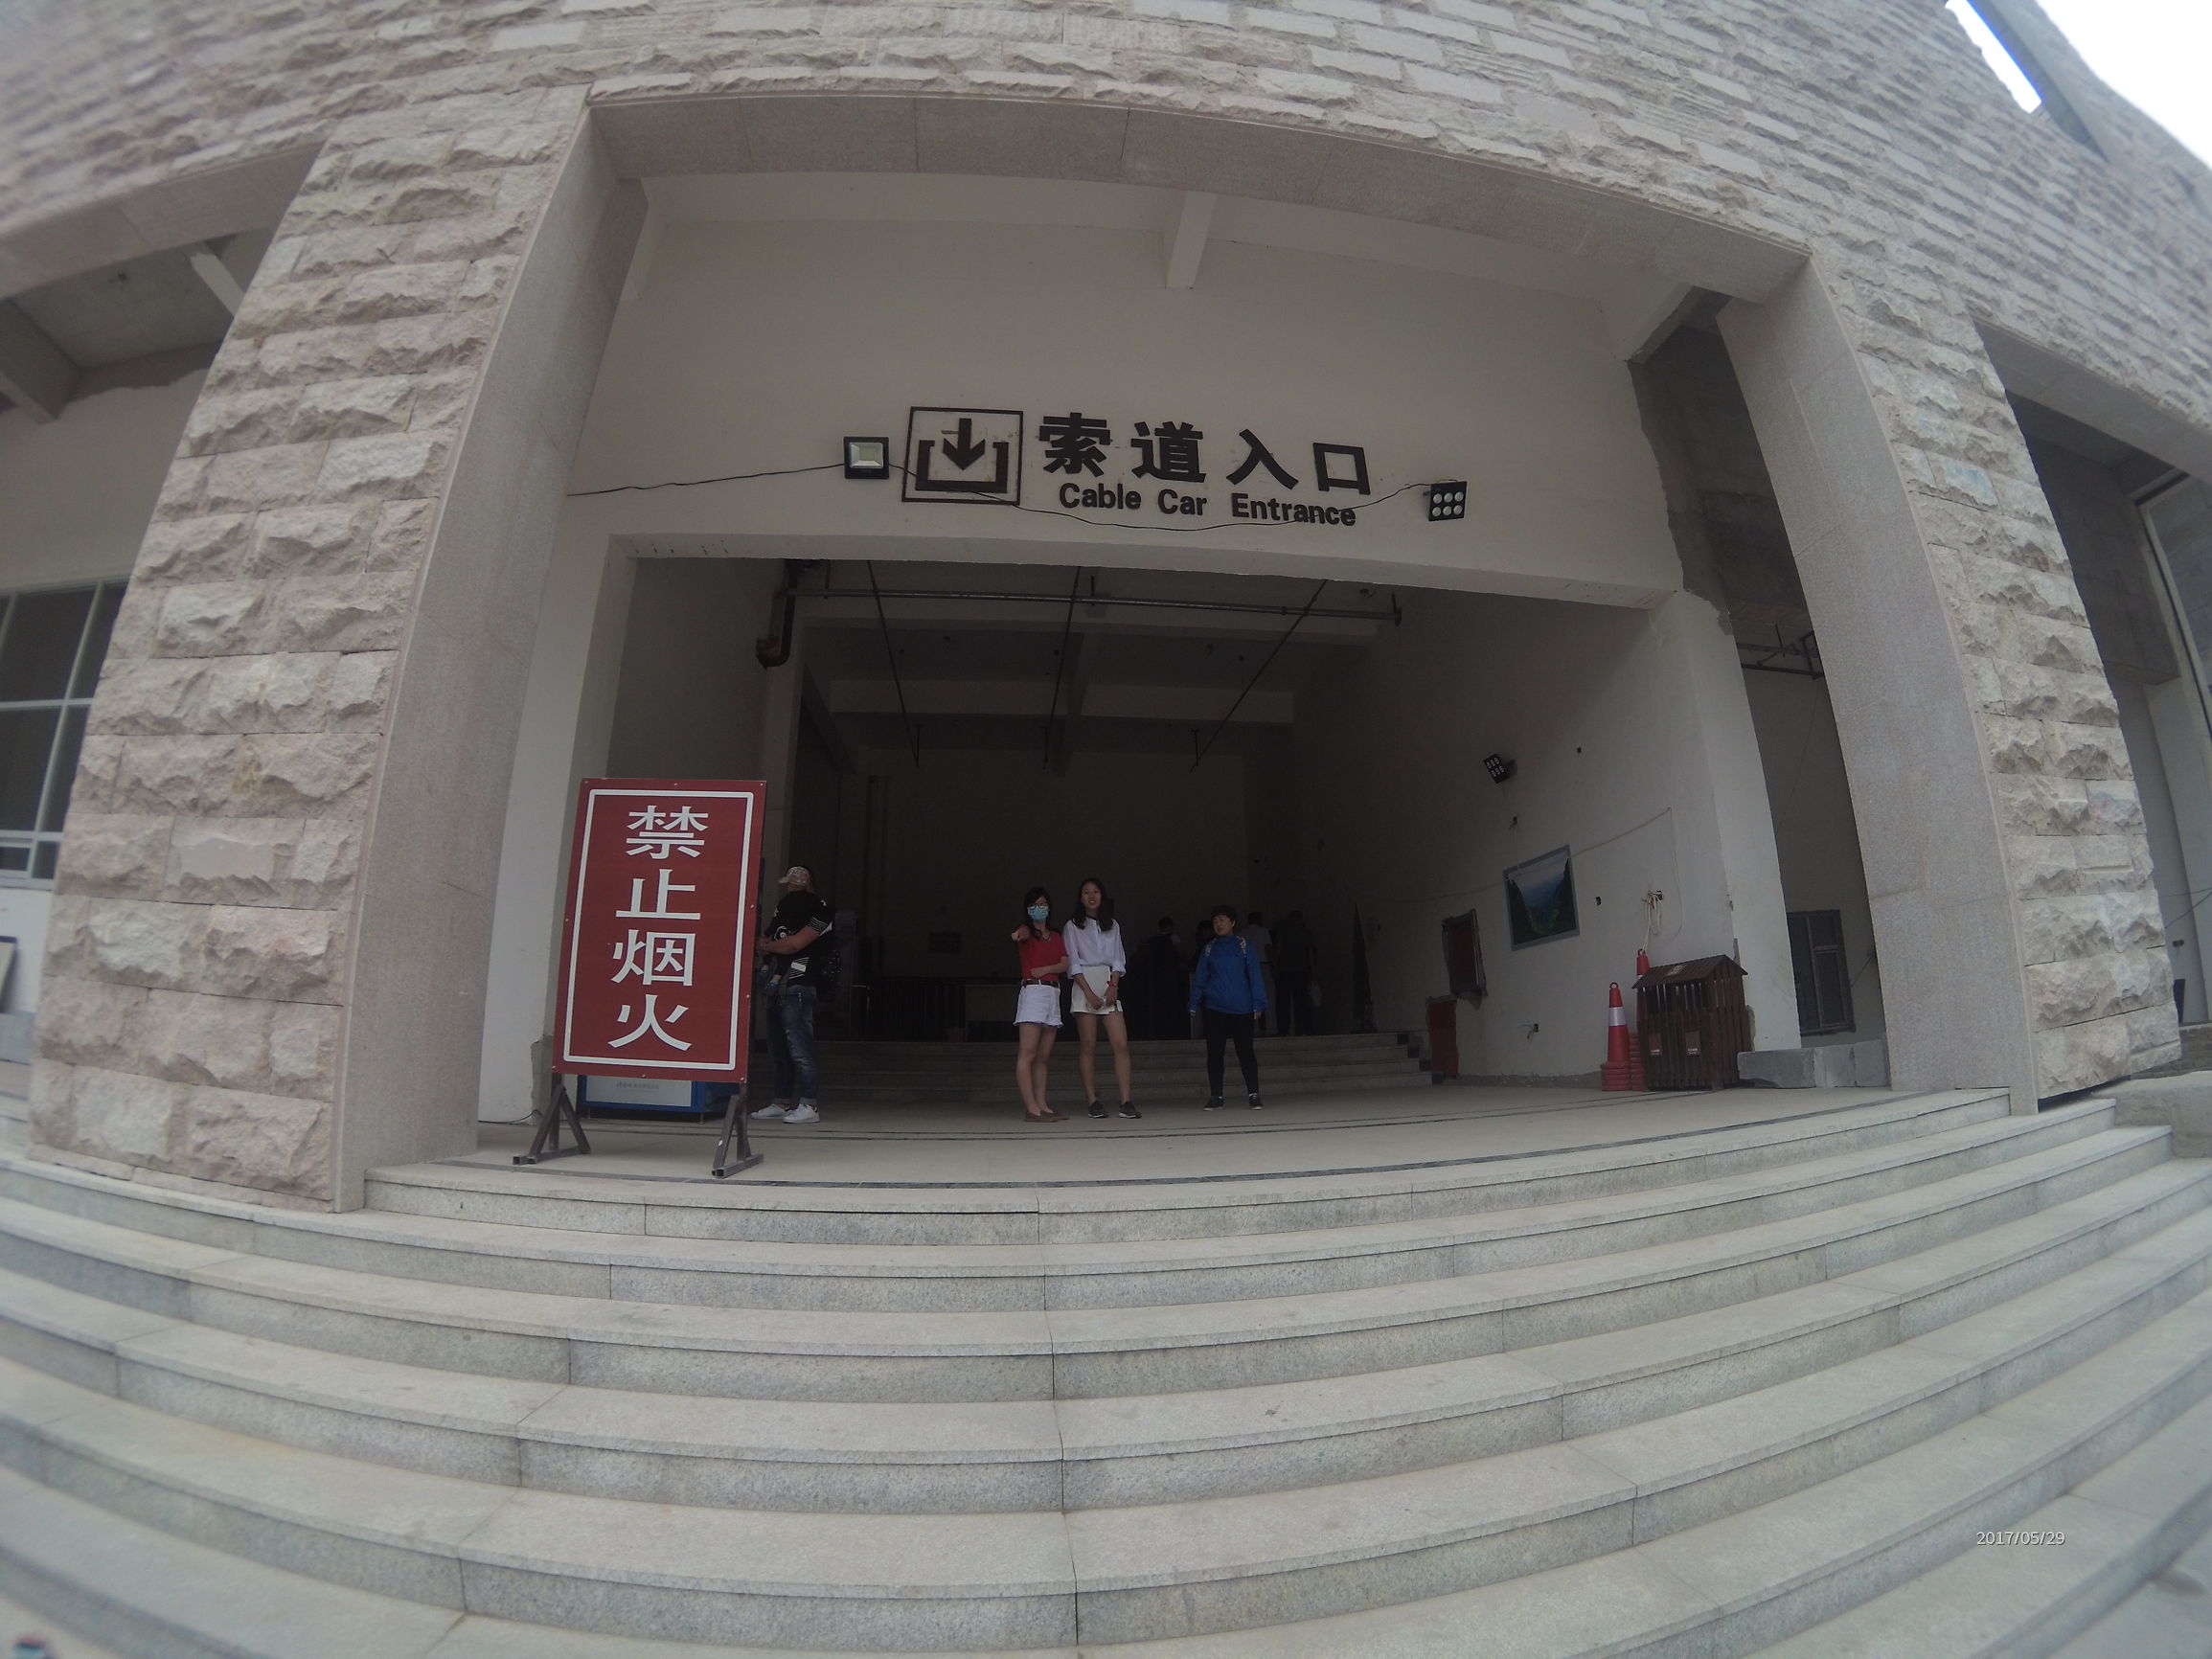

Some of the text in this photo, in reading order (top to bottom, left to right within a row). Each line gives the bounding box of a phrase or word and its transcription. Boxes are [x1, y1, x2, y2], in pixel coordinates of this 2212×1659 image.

[1038, 412, 1371, 495] 索道入口
[1059, 482, 1357, 527] Cable Car Entrance
[607, 805, 709, 1052] 禁止烟火
